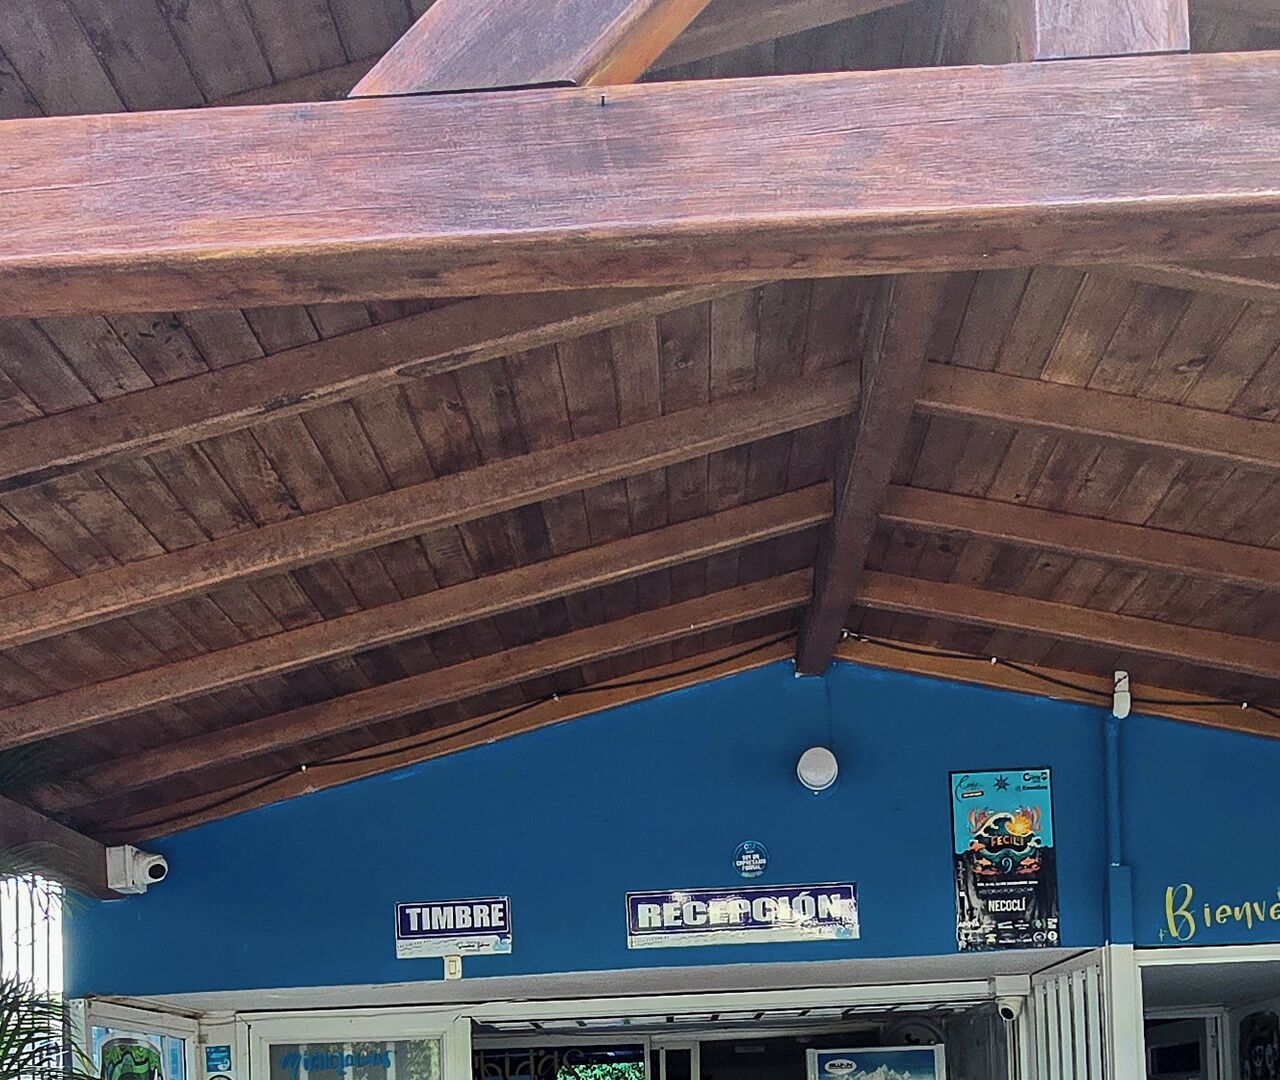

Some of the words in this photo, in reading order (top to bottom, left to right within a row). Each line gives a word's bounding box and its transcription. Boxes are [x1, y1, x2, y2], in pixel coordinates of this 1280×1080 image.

[406, 903, 505, 931] TIMBRE
[637, 890, 843, 928] RECEPCIÓN
[988, 896, 1026, 912] NECOCLÍ
